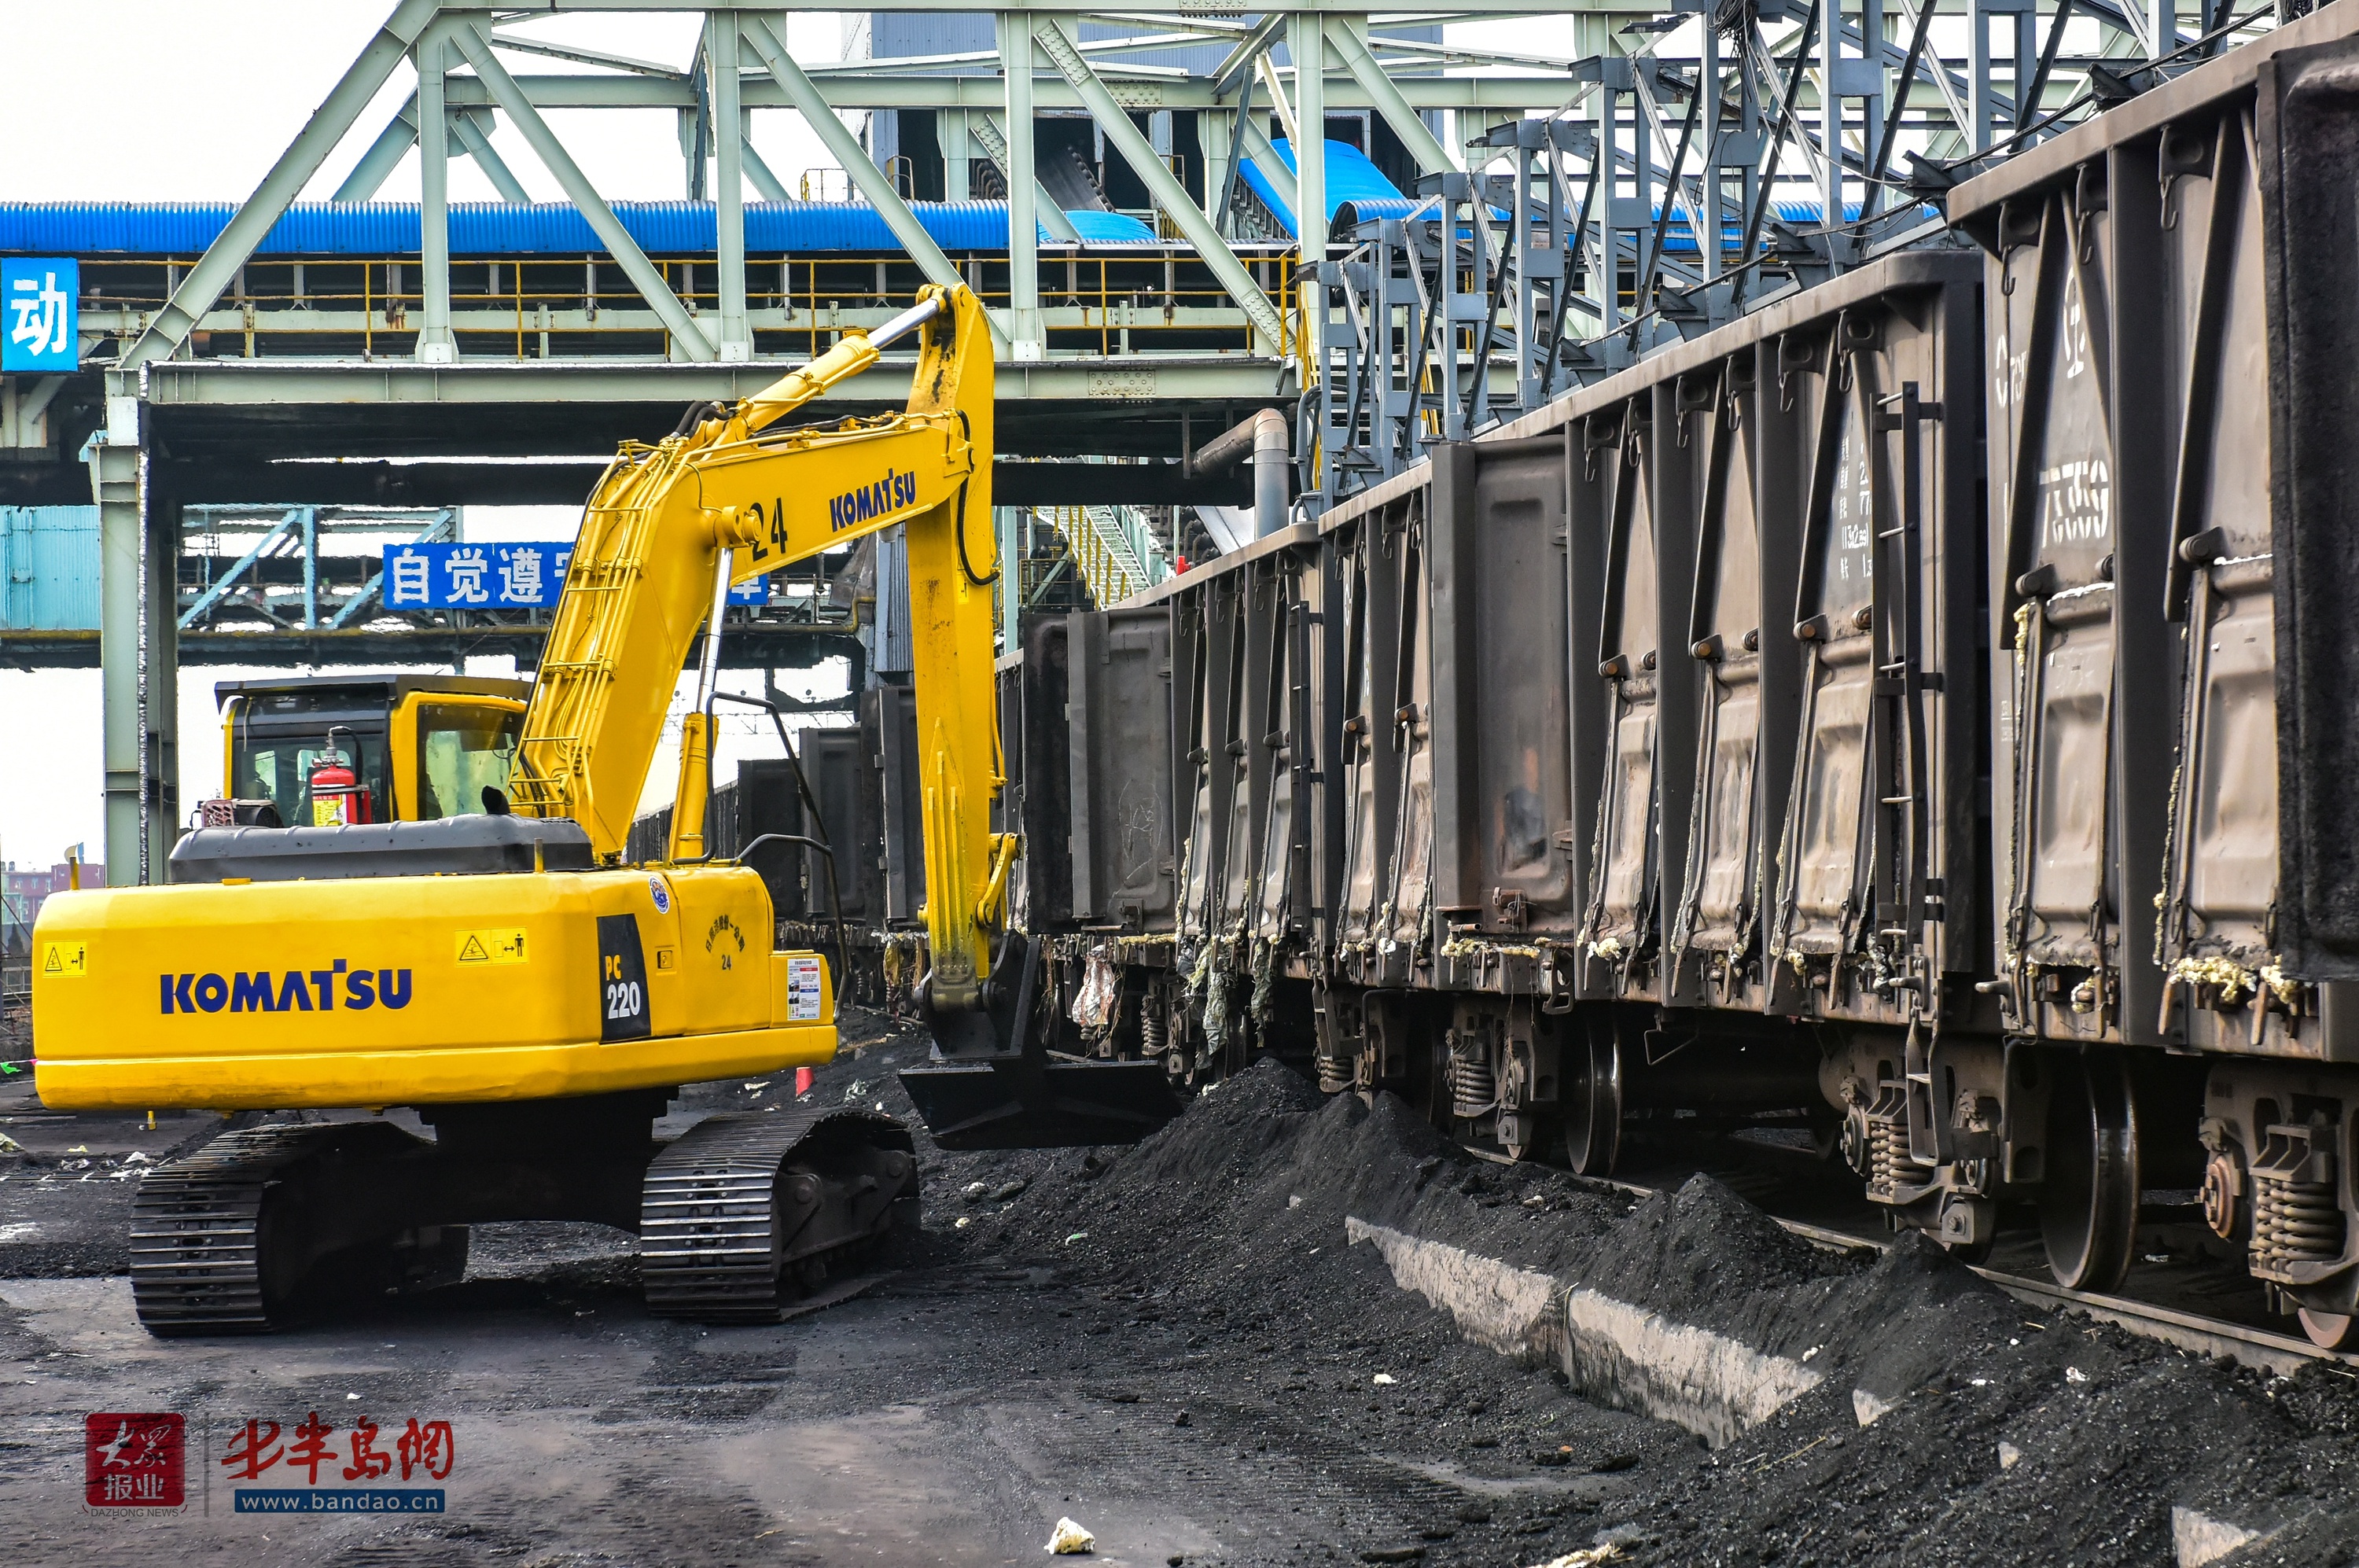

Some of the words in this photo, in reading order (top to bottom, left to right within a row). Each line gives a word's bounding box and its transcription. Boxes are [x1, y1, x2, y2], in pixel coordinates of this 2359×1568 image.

[11, 271, 68, 356] 动
[829, 468, 916, 532] KOMATSU
[749, 497, 788, 562] 24
[160, 959, 412, 1014] KOMATSU
[605, 955, 622, 981] PC
[721, 954, 731, 970] 24
[607, 981, 641, 1020] 220
